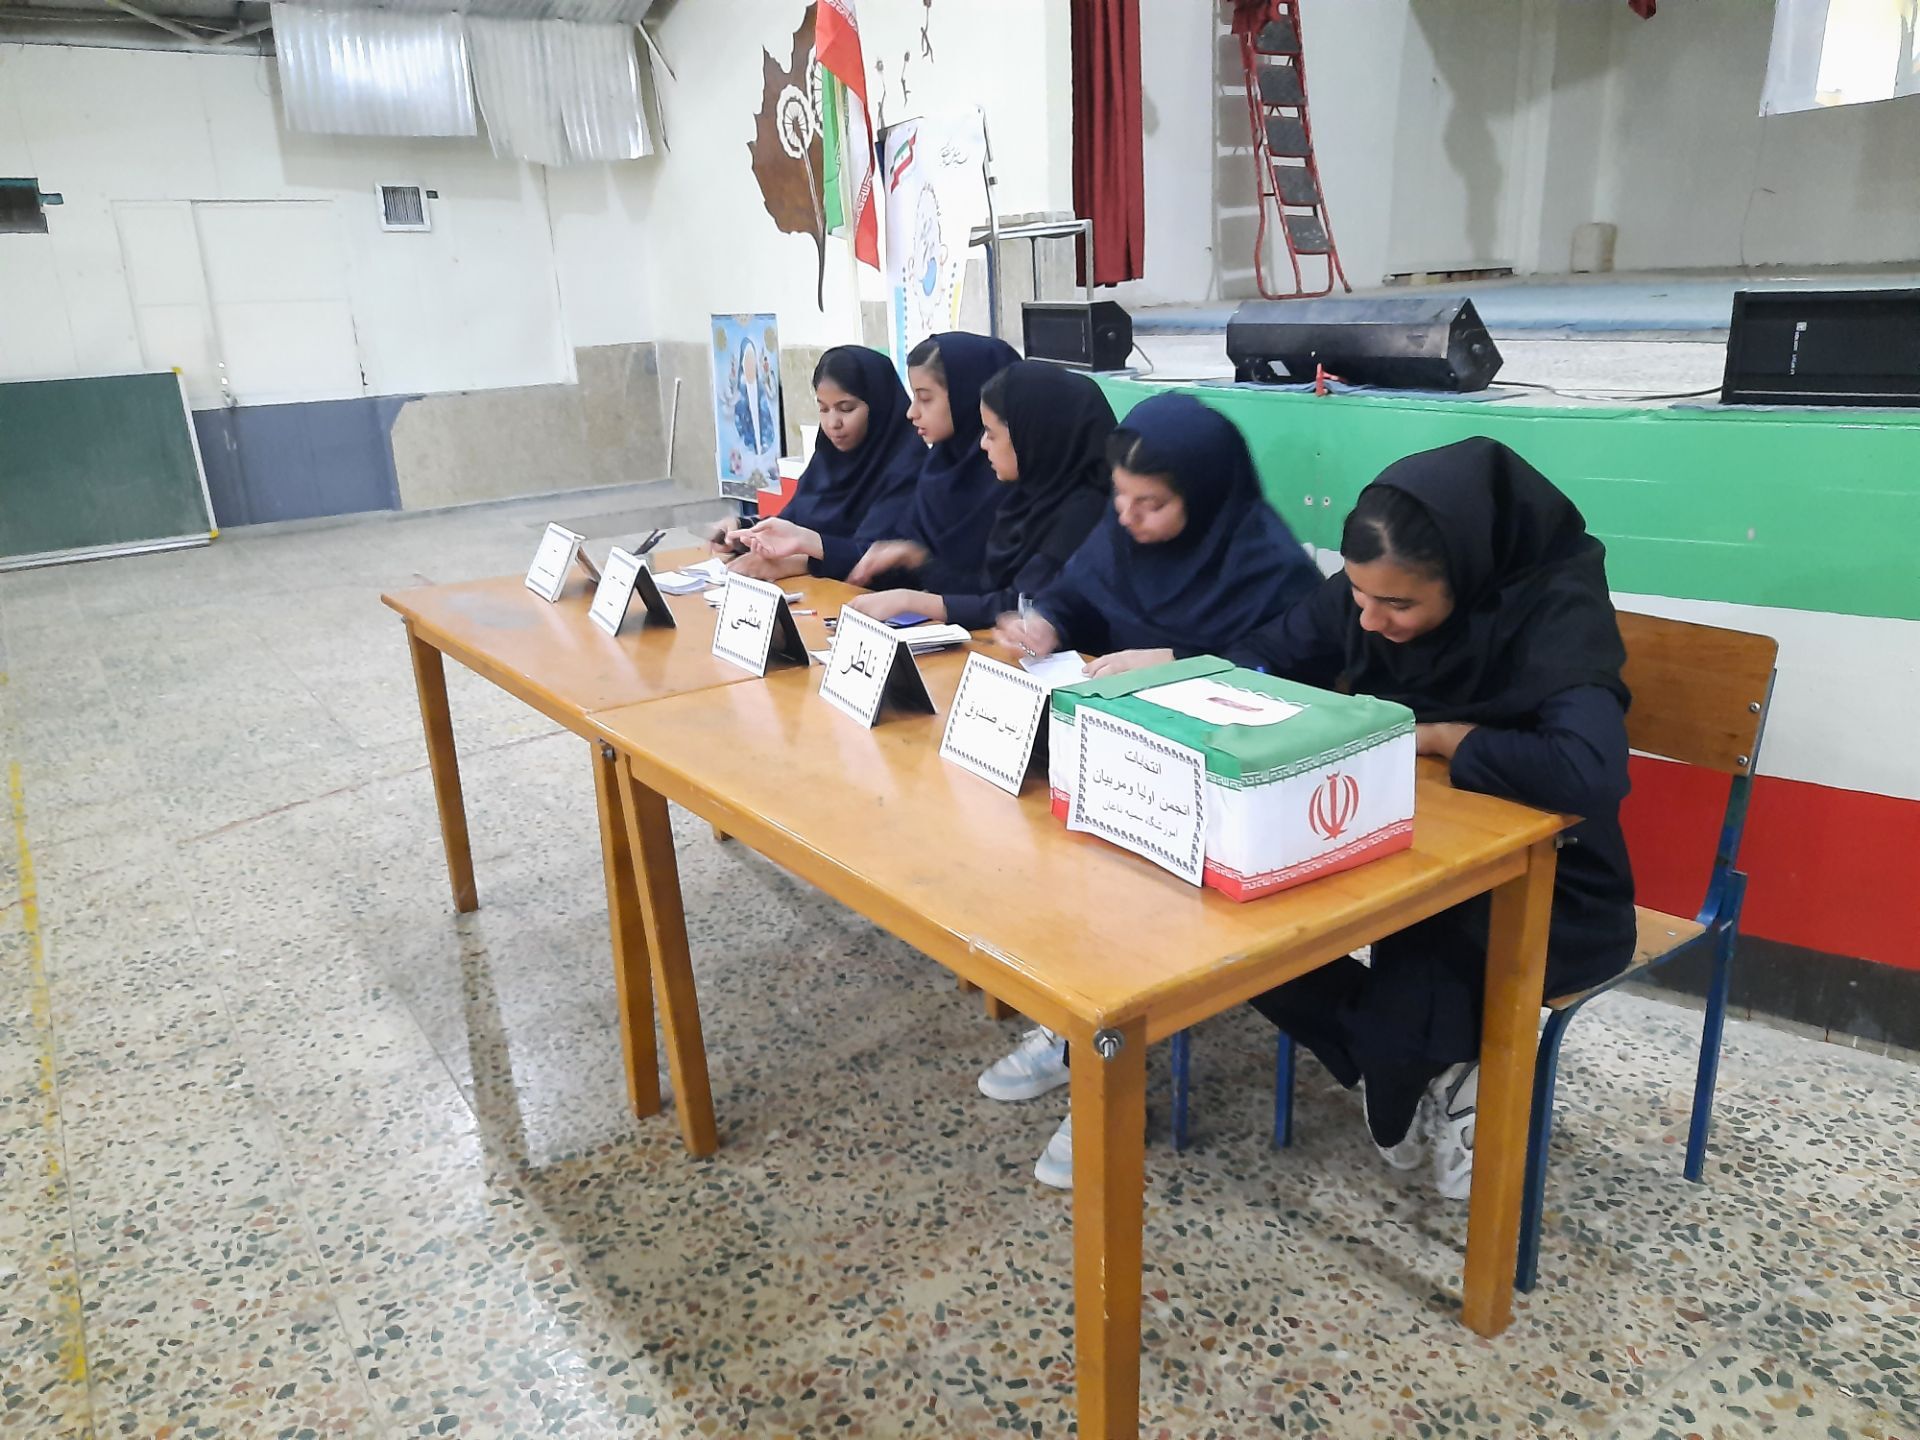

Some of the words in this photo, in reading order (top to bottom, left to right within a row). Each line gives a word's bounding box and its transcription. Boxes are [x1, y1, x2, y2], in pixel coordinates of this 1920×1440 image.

[731, 604, 761, 630] منشی
[840, 641, 877, 678] ناظر
[965, 700, 998, 723] صندوق
[1124, 750, 1162, 775] انتخابات
[1137, 782, 1155, 805] اولیا
[1159, 796, 1190, 816] انجمن
